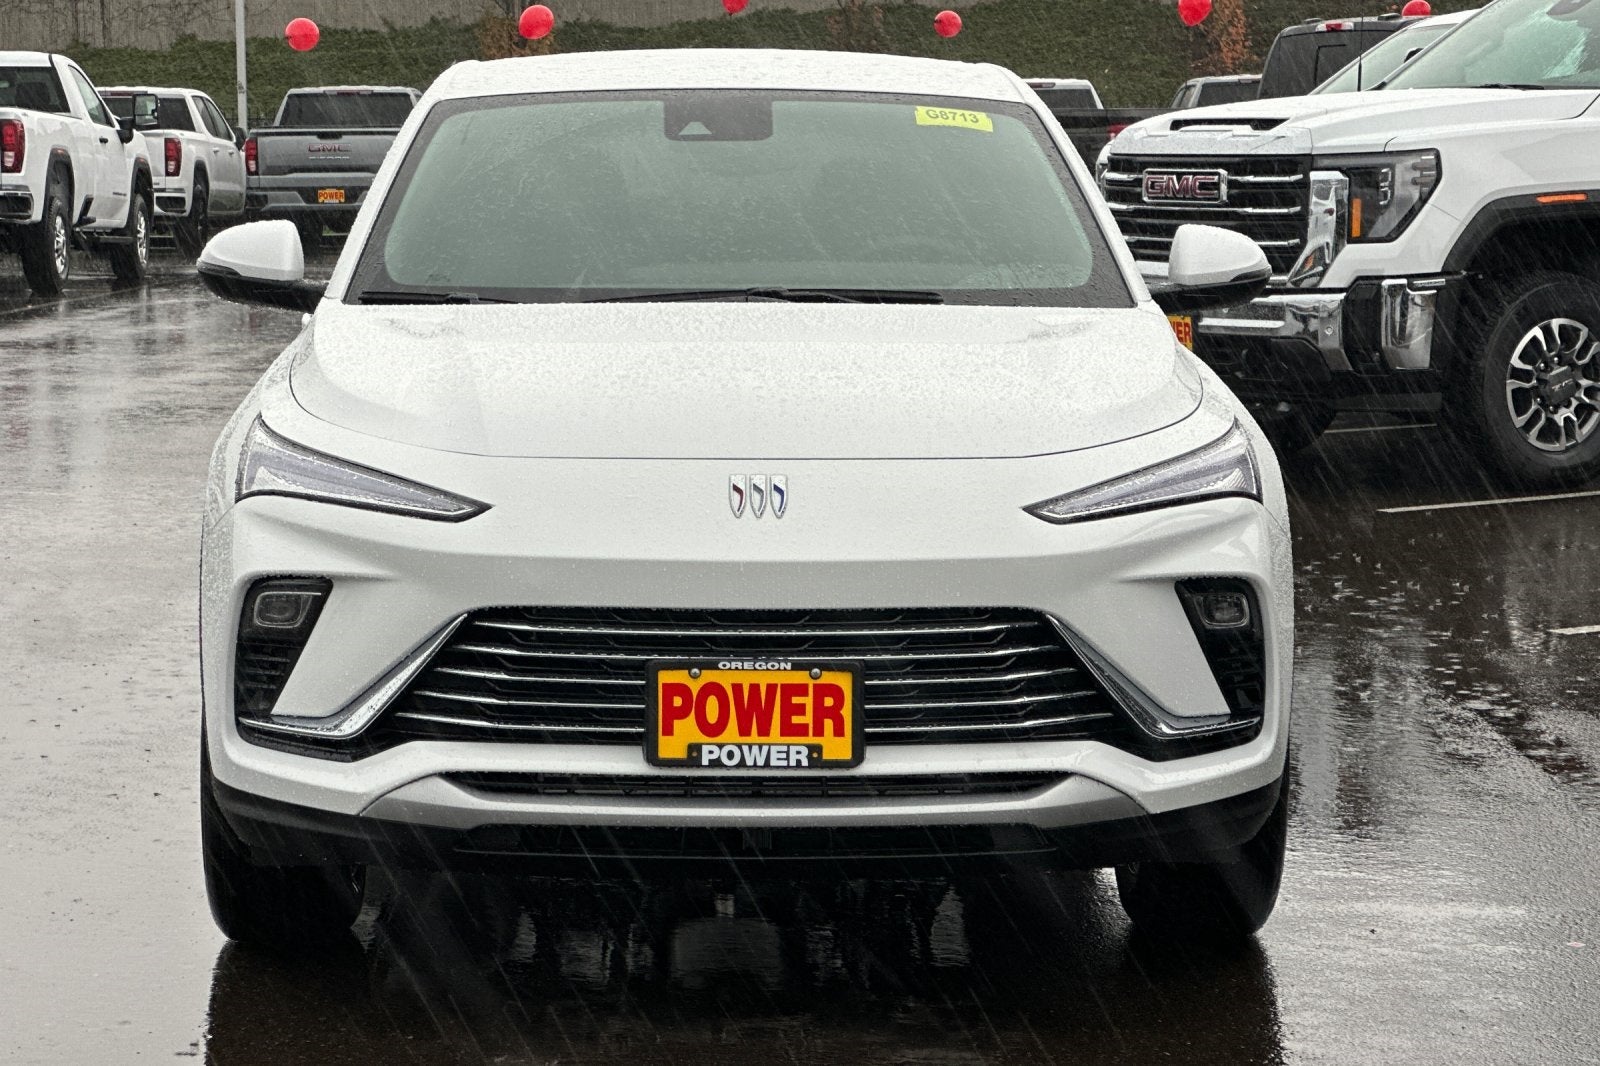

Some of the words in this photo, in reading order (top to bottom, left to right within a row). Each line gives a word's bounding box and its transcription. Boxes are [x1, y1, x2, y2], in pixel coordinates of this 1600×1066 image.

[925, 108, 979, 124] G8713
[308, 143, 351, 152] GMC
[1145, 175, 1219, 198] GMC
[318, 191, 344, 200] POWER
[717, 661, 792, 670] OREGON
[661, 681, 845, 738] POWER
[701, 744, 809, 767] POWER
